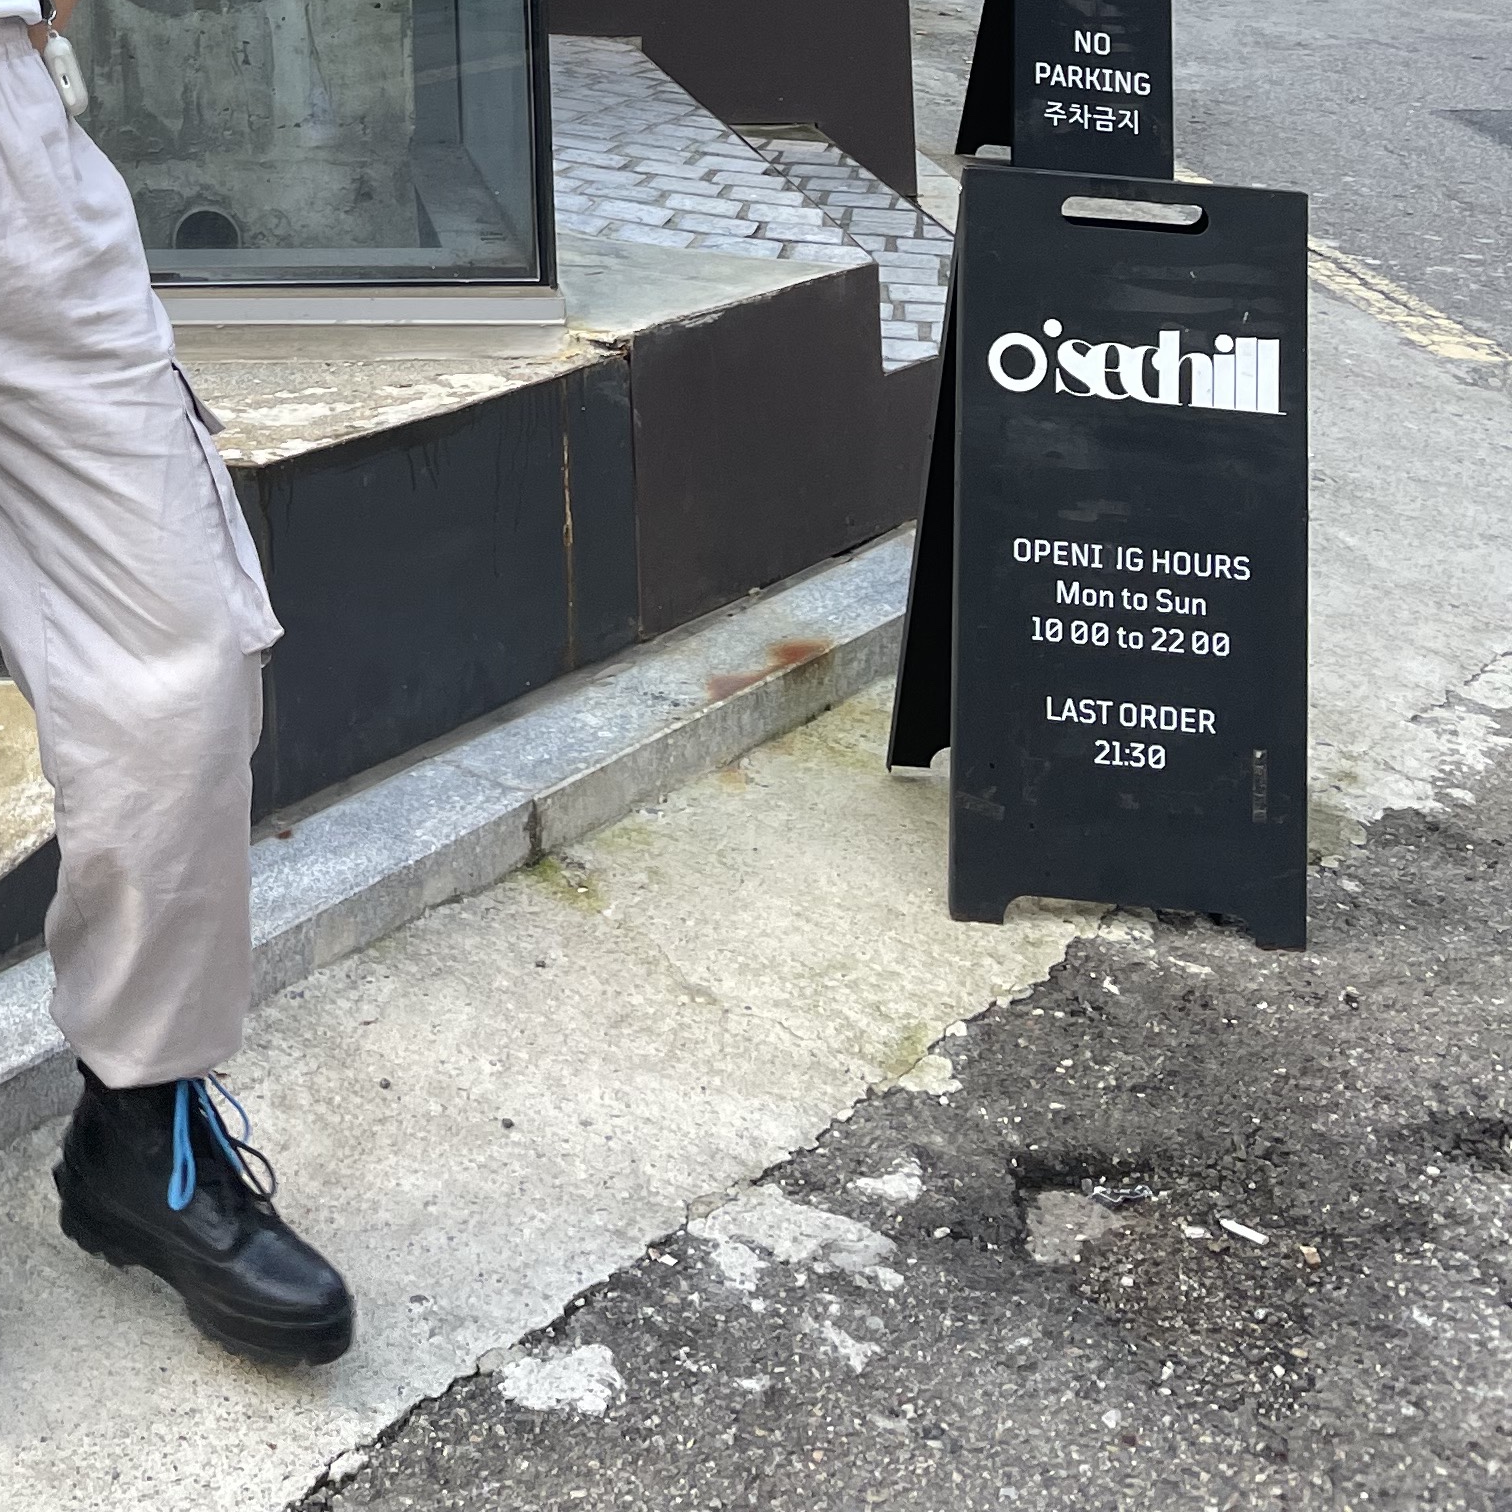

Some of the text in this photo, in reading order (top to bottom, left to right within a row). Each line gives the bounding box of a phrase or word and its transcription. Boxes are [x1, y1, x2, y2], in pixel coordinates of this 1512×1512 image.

[1074, 30, 1111, 56] NO
[1035, 61, 1151, 96] PARKING
[1043, 101, 1139, 135] 주차금지
[1152, 549, 1251, 581] HOURS
[1056, 579, 1207, 616] Mon to Sun
[1116, 626, 1144, 650] to
[1046, 696, 1216, 735] LAST ORDER
[1093, 739, 1166, 770] 21:30
